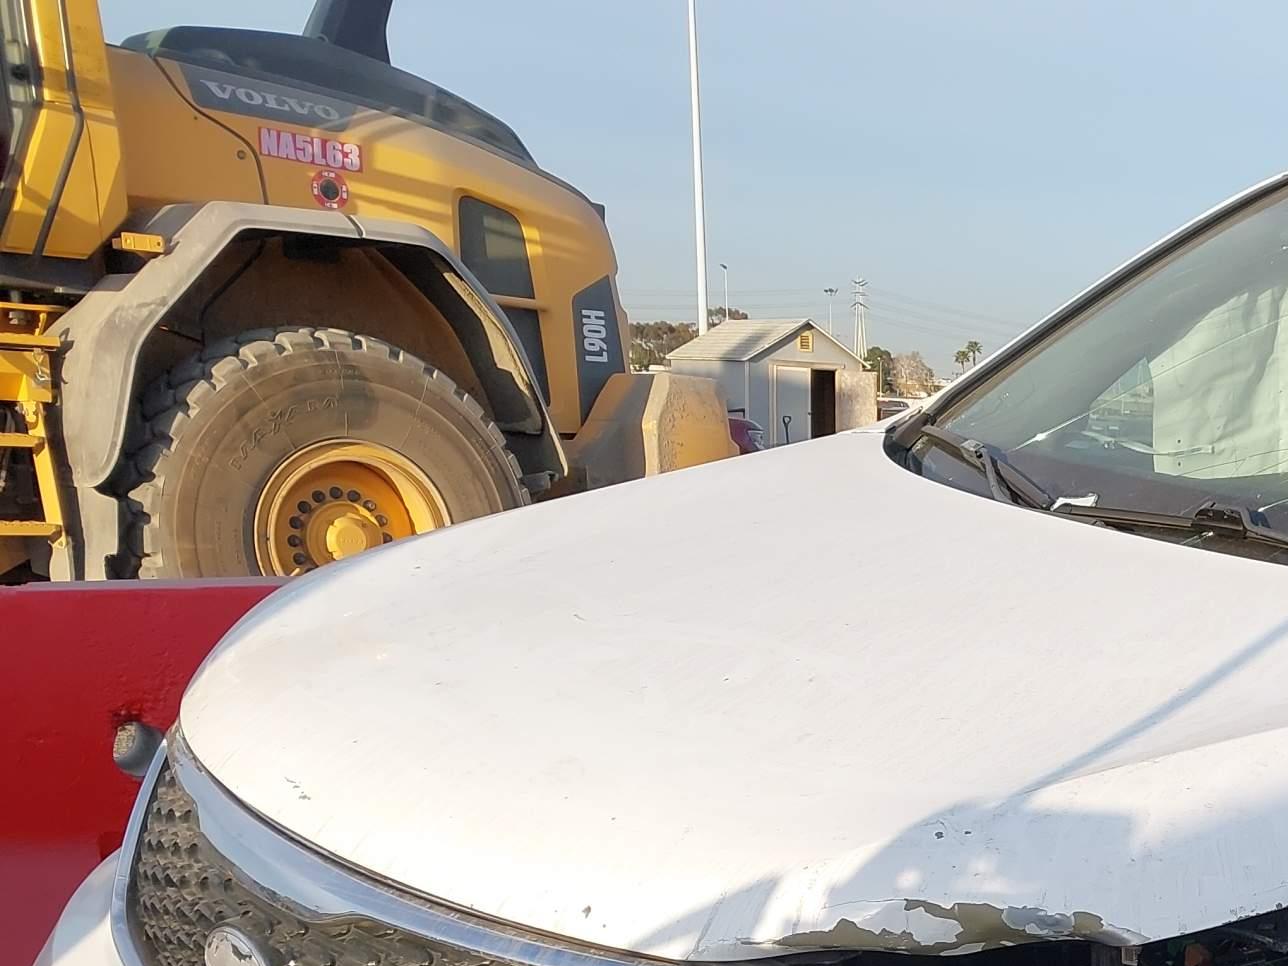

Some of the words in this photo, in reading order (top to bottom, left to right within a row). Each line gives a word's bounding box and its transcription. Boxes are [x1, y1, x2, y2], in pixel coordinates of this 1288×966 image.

[200, 79, 340, 121] VOLVO
[260, 127, 361, 172] NA5L63
[581, 309, 608, 363] L90H
